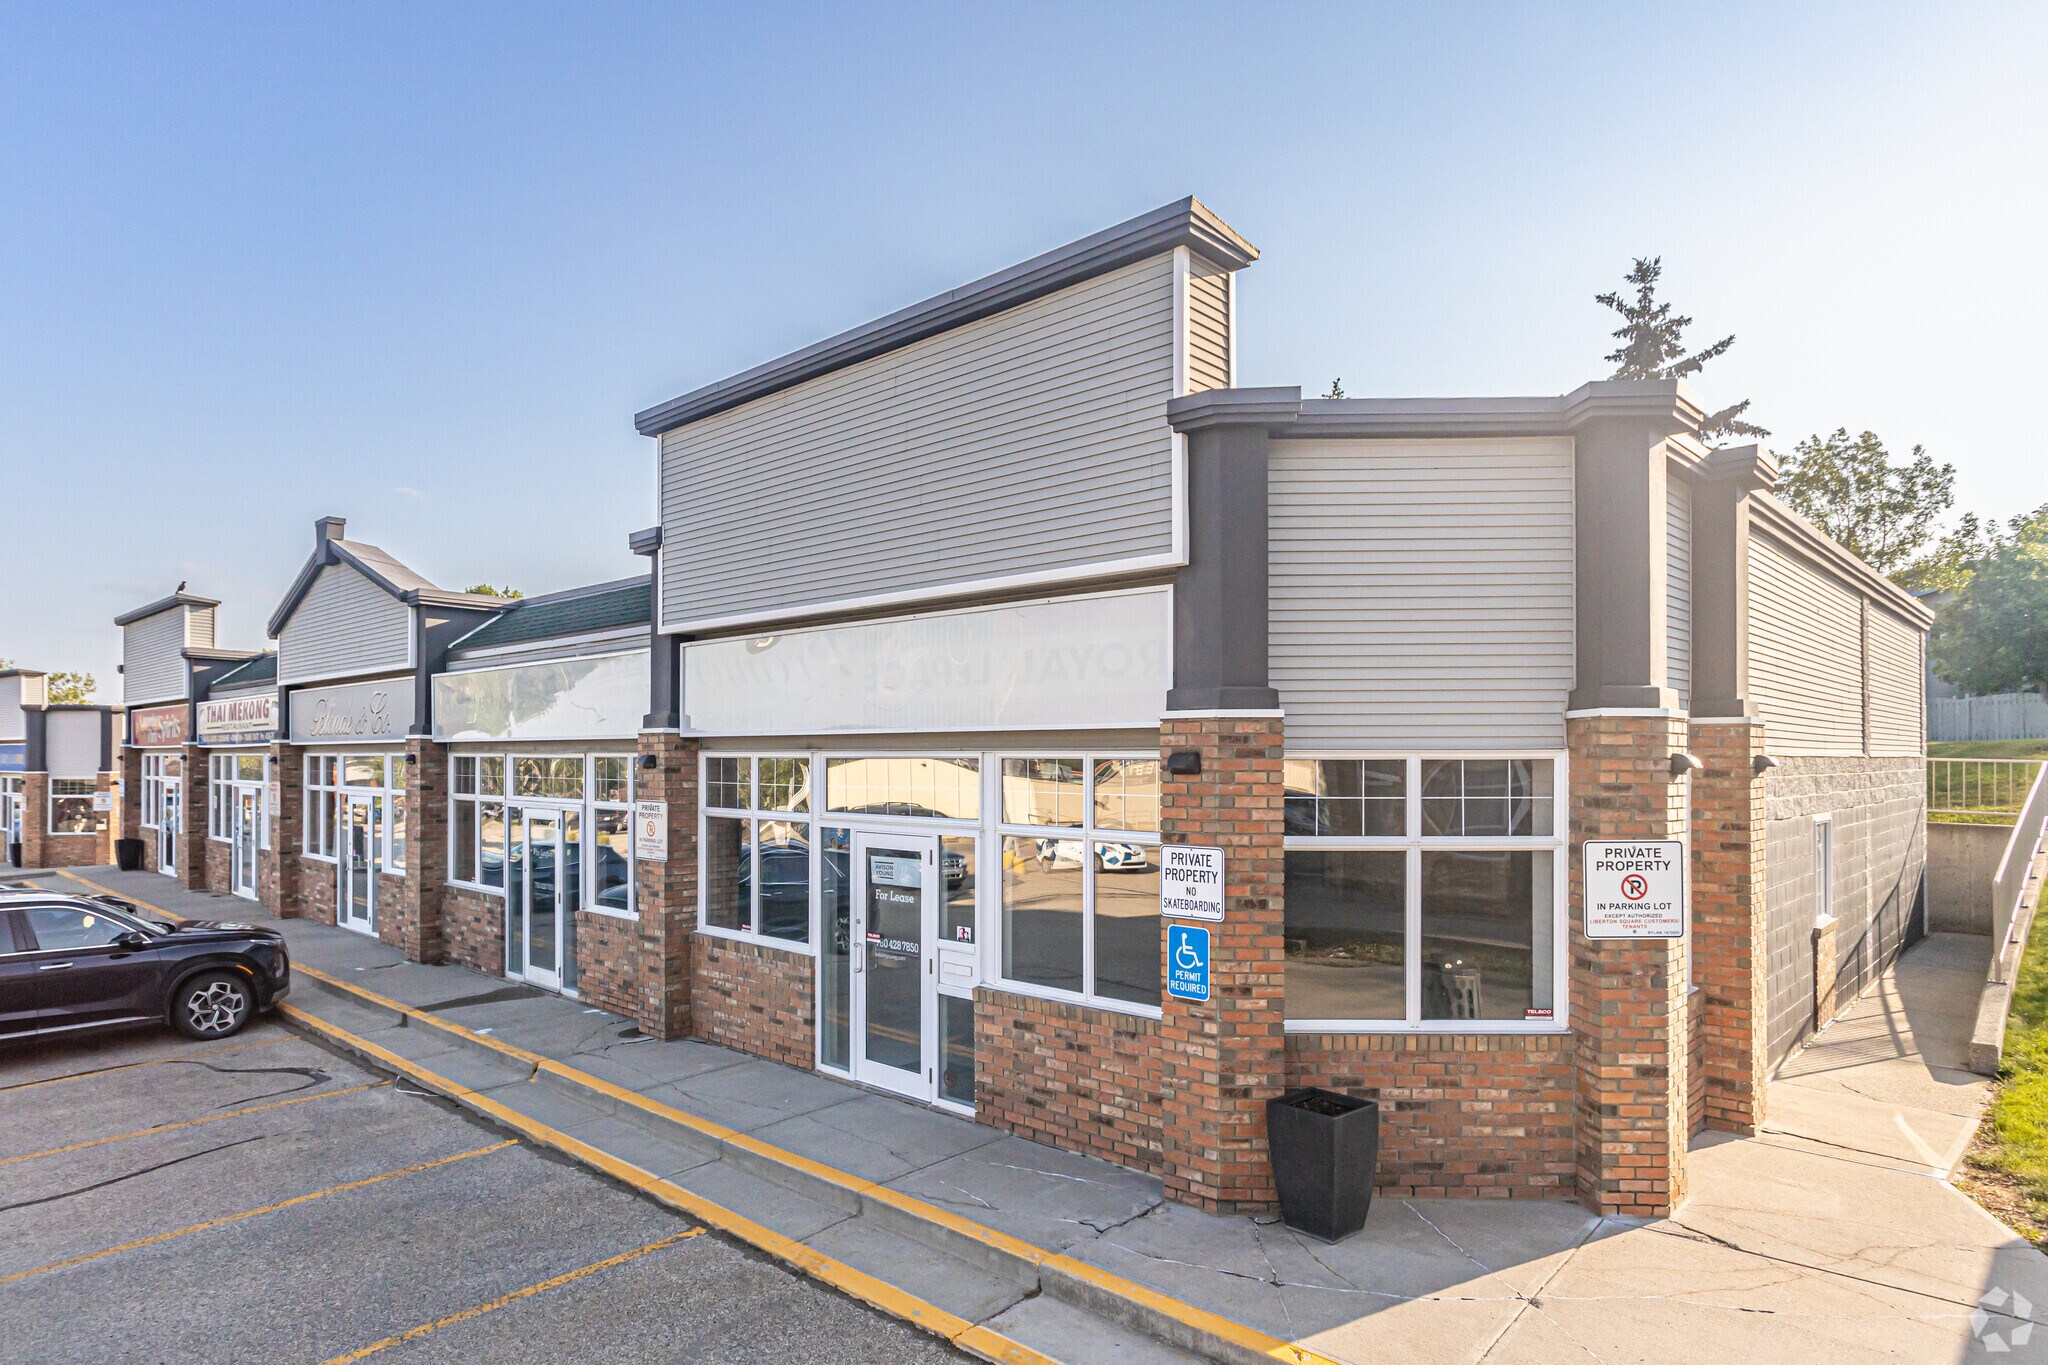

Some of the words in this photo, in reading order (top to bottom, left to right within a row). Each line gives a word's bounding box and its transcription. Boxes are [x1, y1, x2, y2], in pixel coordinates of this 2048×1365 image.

[207, 704, 226, 723] THAI
[228, 698, 270, 722] MEKONG
[221, 722, 252, 730] RESTAURANT
[1171, 852, 1212, 867] PRIVATE
[1605, 848, 1662, 858] PRIVATE
[1596, 861, 1671, 871] PROPERTY
[1165, 868, 1218, 884] PROPERTY
[875, 889, 889, 900] For
[890, 890, 915, 903] Lease
[1186, 887, 1197, 896] NO
[1163, 897, 1221, 914] SKATEBOARDING
[889, 939, 901, 950] 428
[902, 941, 919, 953] 7850
[1175, 969, 1201, 982] PERMIT
[1170, 980, 1206, 995] REQUIRED
